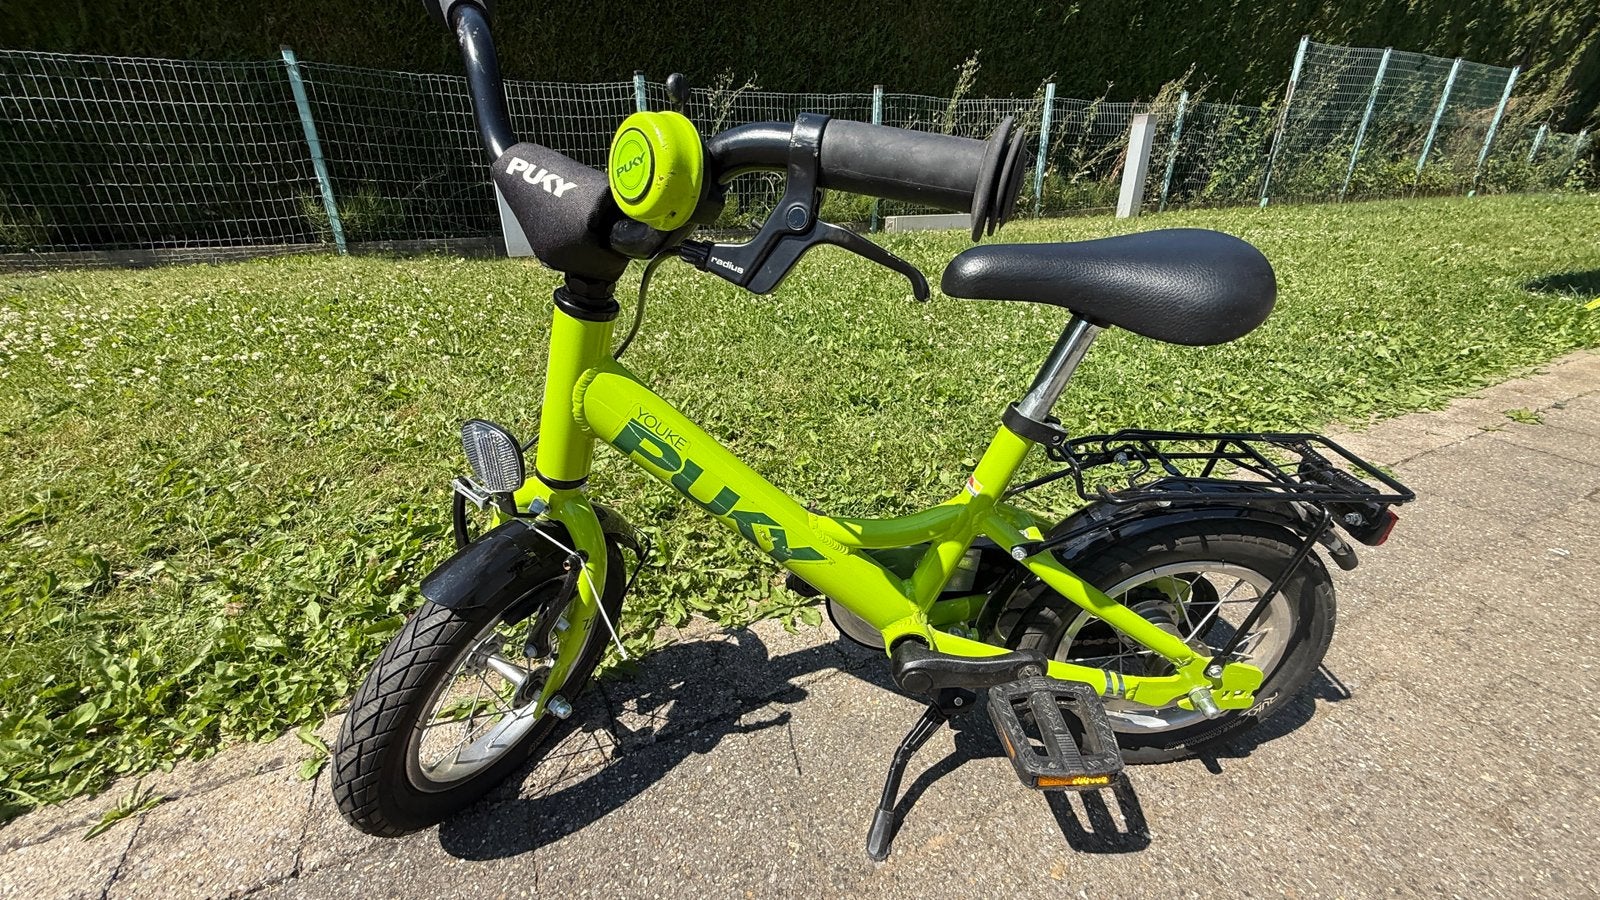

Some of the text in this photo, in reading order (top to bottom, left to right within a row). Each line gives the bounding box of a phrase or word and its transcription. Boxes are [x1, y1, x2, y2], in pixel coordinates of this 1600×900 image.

[506, 157, 578, 197] PUKY
[616, 152, 645, 177] PUKY
[710, 256, 744, 274] radius
[636, 406, 687, 451] YOUKE
[612, 418, 827, 563] PUKY
